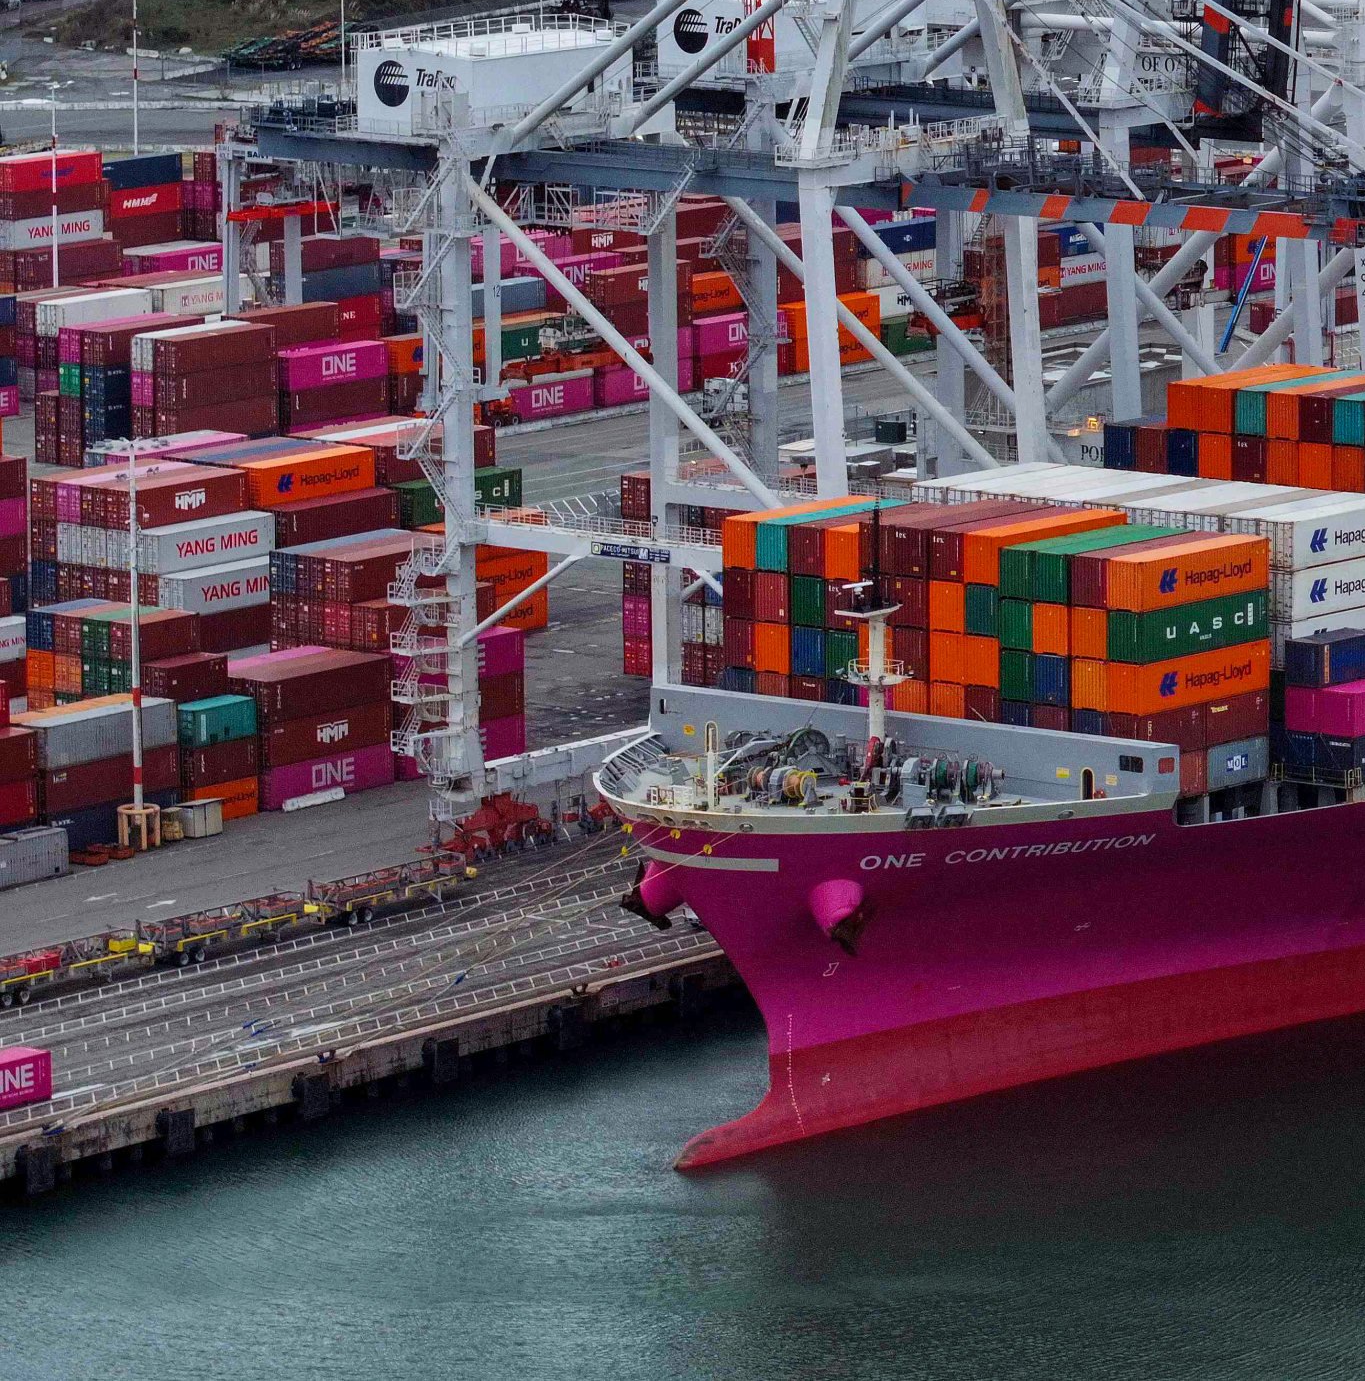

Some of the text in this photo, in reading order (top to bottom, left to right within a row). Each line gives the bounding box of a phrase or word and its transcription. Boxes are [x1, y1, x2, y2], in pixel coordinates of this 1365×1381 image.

[61, 219, 90, 234] MING
[592, 233, 614, 248] HMM
[911, 260, 933, 271] MING
[1067, 261, 1107, 276] YANG MING
[493, 285, 501, 298] 12
[322, 352, 356, 376] ONE
[532, 385, 564, 409] ONE
[300, 466, 360, 488] Hapag-Lloyd
[175, 488, 206, 510] HMM
[176, 529, 258, 559] YANG MING
[1185, 559, 1252, 586] Hapag-Lloyd
[202, 581, 241, 603] YANG
[1166, 611, 1244, 639] UASC
[1185, 661, 1252, 689] Hapag-Lloyd
[317, 719, 349, 744] HMM
[312, 757, 355, 789] ONE
[1227, 756, 1248, 770] MOL
[860, 833, 1156, 870] ONE CONTRIBUTION
[0, 1063, 34, 1094] NE
